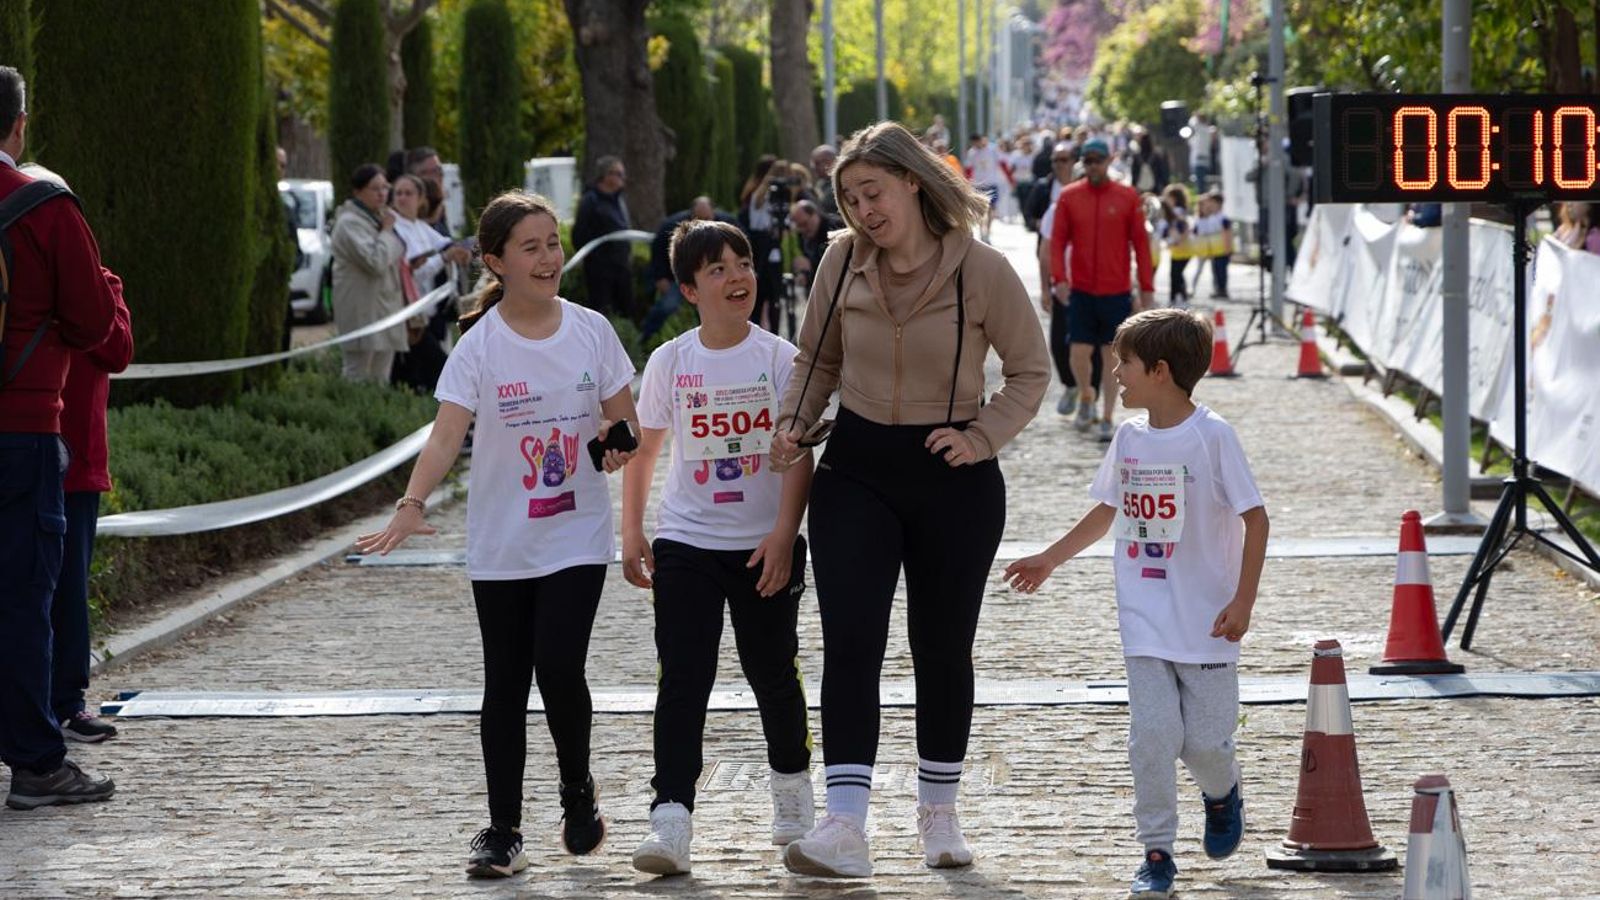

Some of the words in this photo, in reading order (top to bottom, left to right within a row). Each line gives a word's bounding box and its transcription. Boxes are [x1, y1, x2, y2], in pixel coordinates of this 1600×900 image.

[497, 381, 529, 398] XXVII
[676, 374, 704, 388] XXVII
[691, 407, 773, 438] 5504
[1123, 491, 1177, 520] 5505
